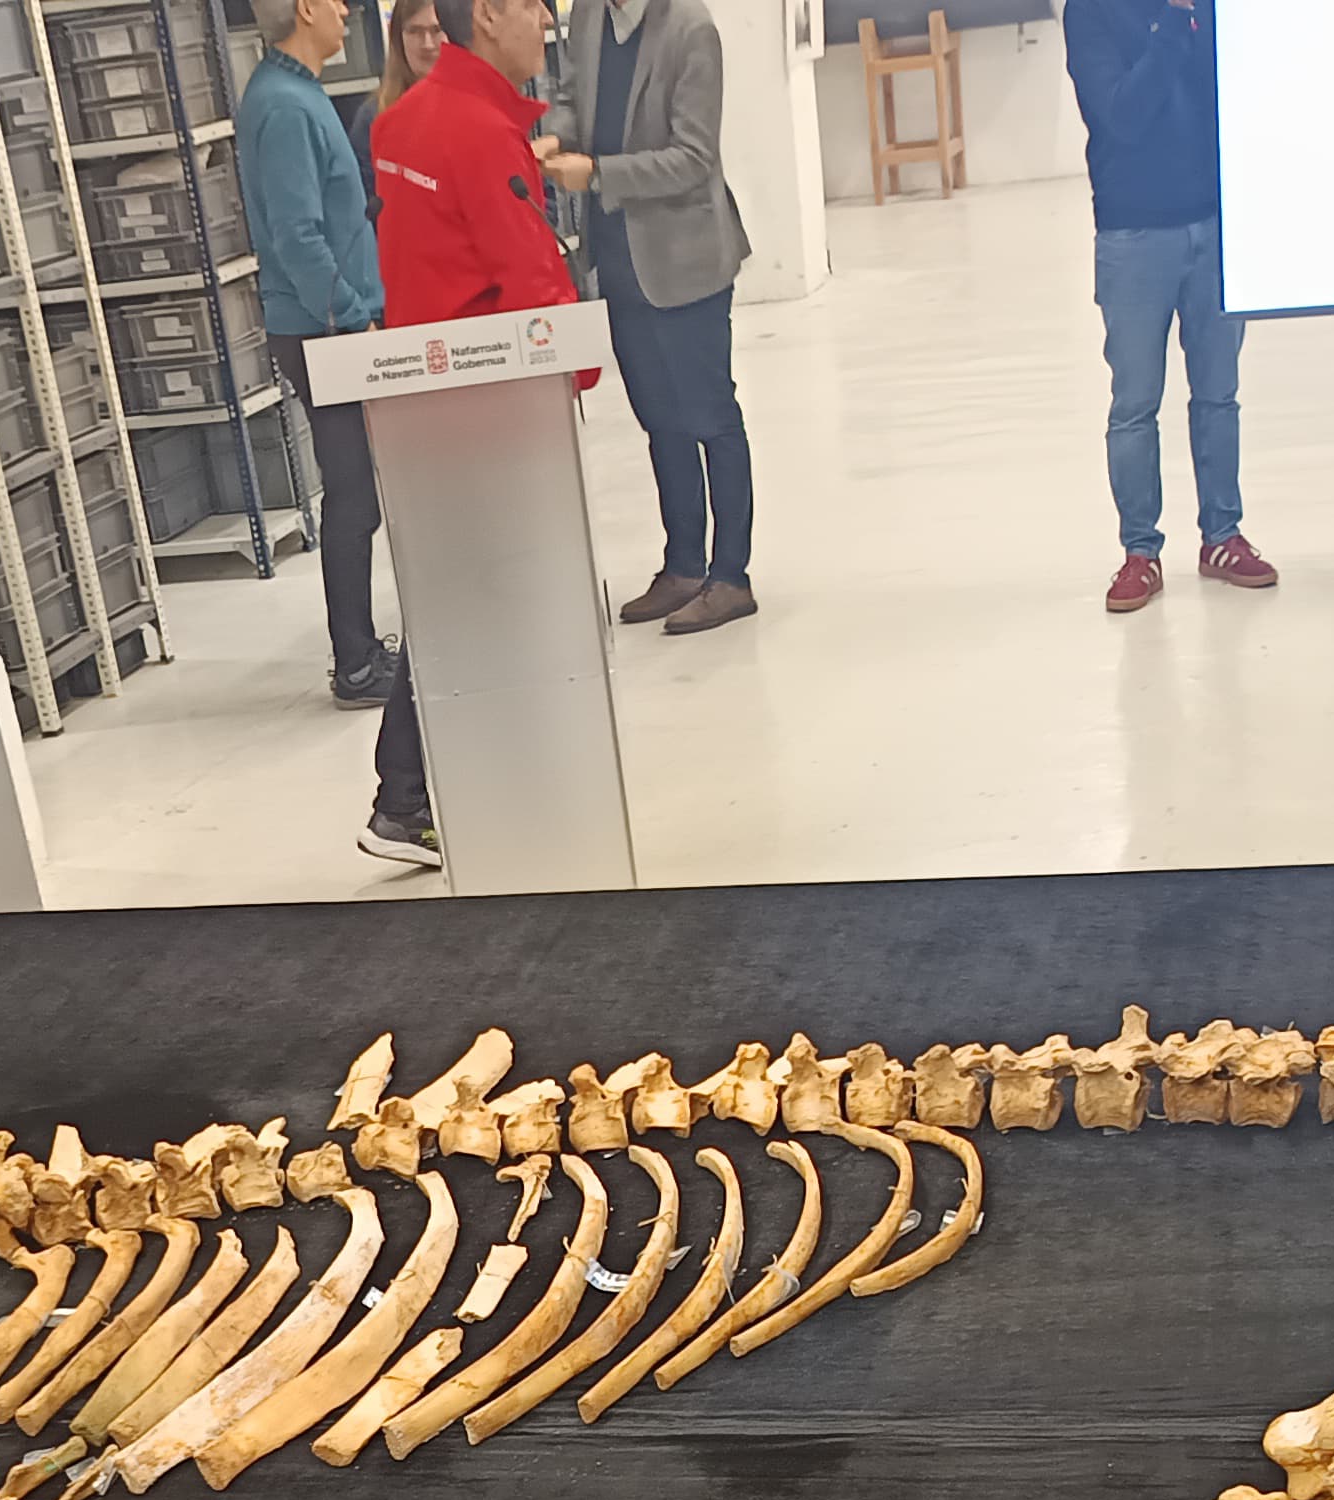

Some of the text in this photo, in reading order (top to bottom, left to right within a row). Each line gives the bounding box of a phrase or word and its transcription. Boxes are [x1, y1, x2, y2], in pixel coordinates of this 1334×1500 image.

[451, 340, 511, 357] Nafarroako
[373, 353, 422, 369] Gobierno
[453, 356, 506, 371] Gobernua
[366, 367, 424, 383] de Navarra
